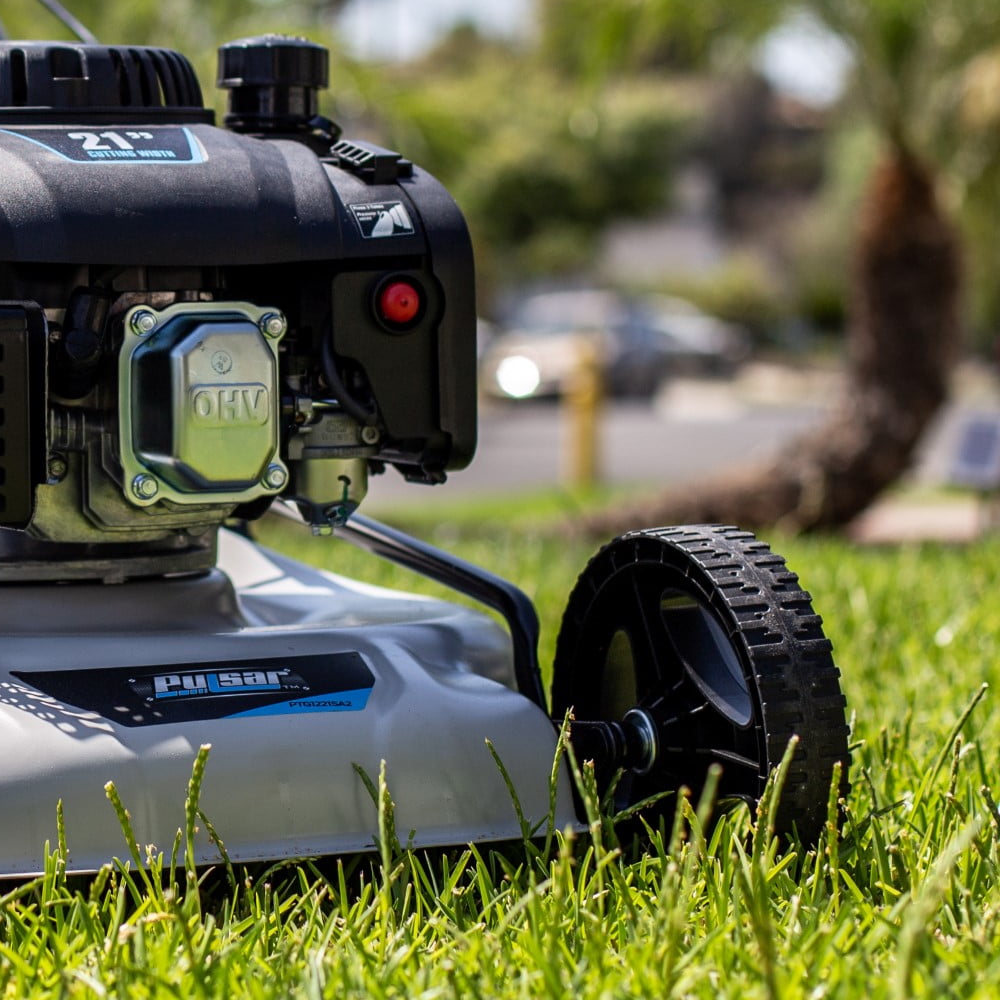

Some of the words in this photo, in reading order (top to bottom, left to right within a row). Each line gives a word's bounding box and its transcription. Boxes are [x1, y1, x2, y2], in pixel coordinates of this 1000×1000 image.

[87, 150, 137, 158] CUTTING
[136, 150, 176, 158] WIDTH
[194, 389, 265, 423] OHV
